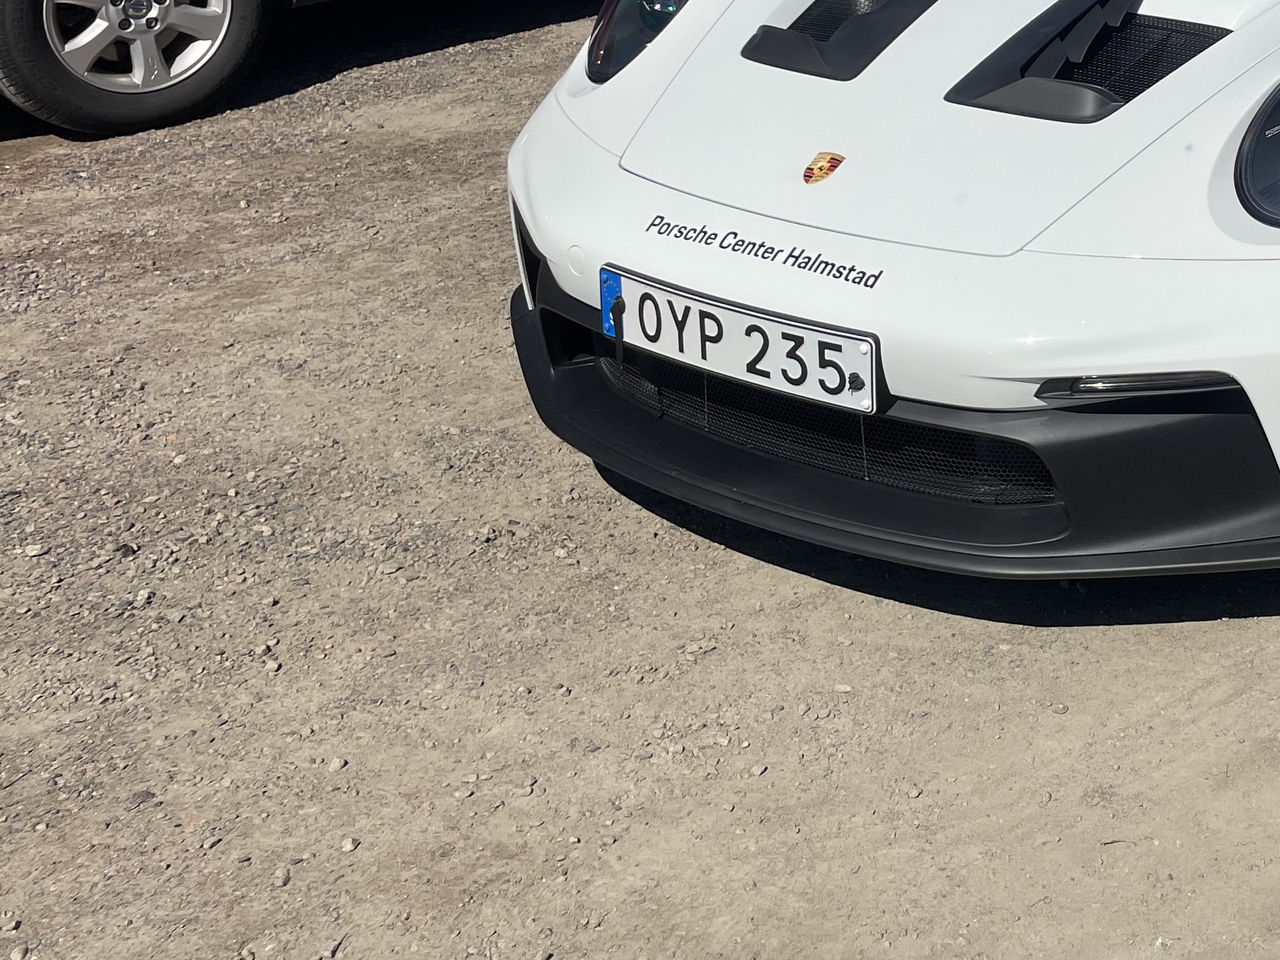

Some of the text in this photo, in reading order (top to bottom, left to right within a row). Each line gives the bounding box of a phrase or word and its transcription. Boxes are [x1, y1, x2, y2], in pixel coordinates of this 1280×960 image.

[645, 215, 884, 289] Porsche Center Halmstad
[638, 292, 847, 395] OYP 235
